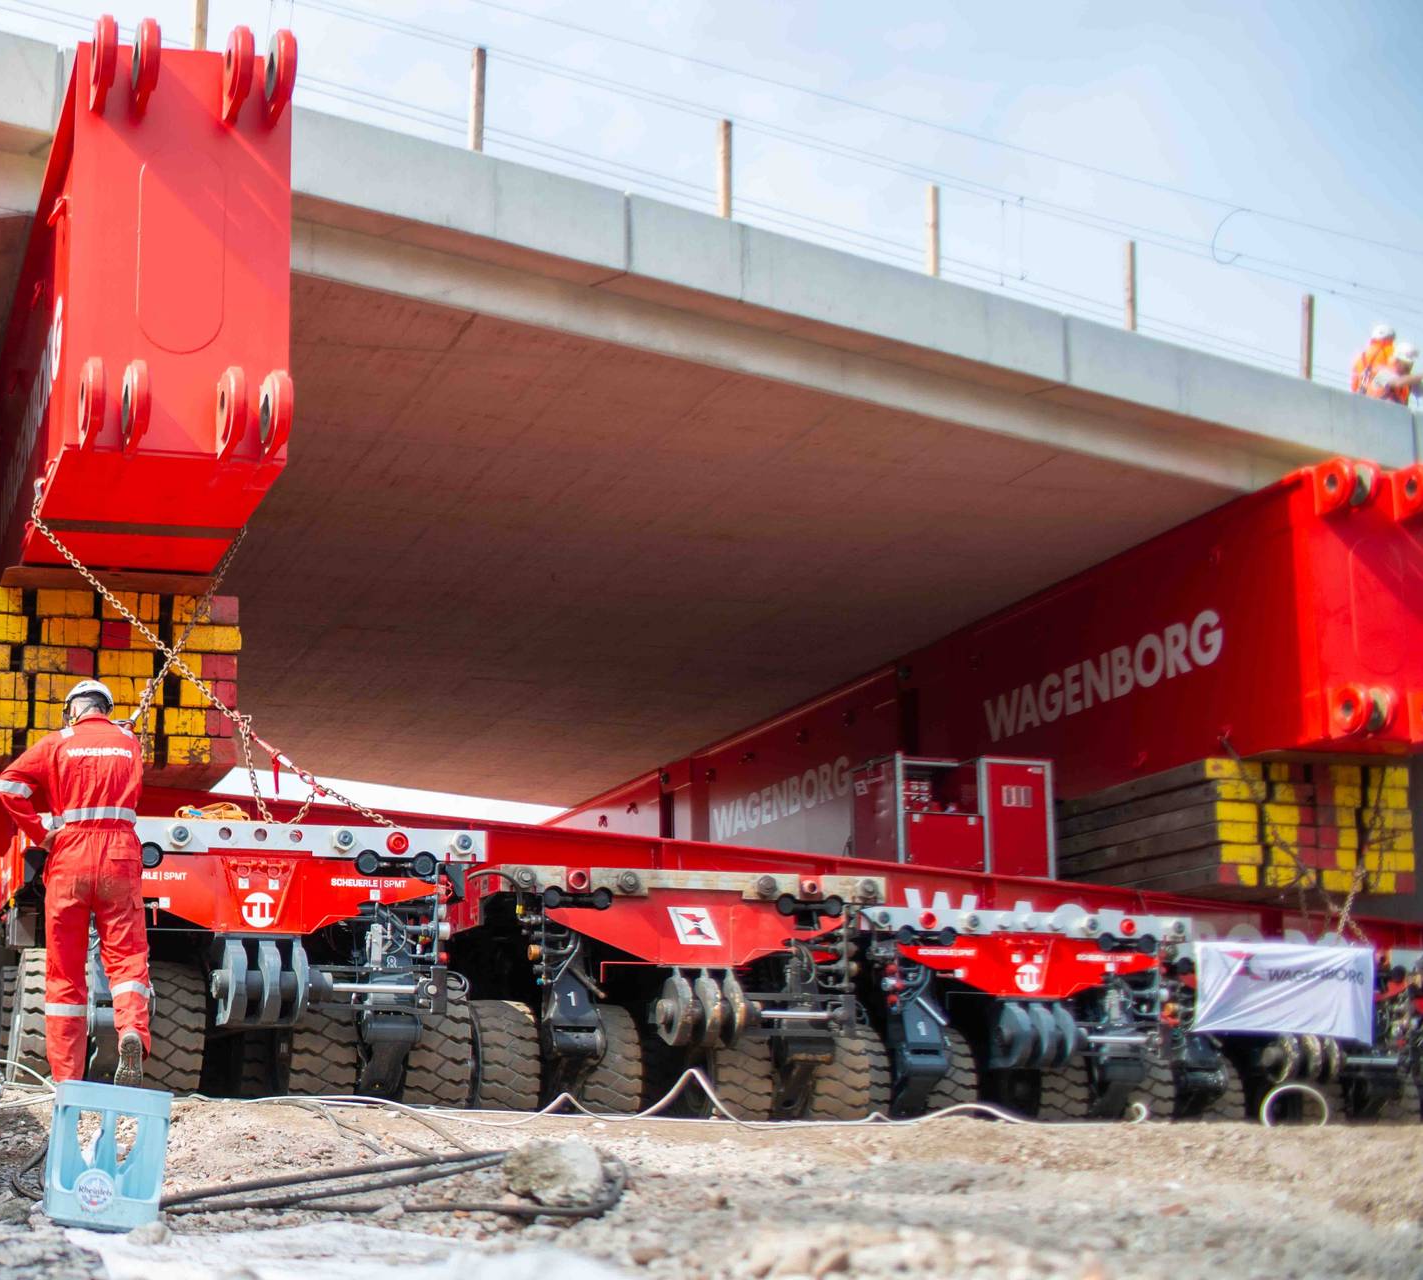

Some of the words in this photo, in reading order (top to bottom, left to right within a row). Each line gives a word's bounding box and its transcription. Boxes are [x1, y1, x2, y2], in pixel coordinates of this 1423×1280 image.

[983, 610, 1223, 742] WAGENBORG
[66, 747, 133, 760] WAGENBORG
[713, 756, 850, 841] WAGENBORG
[163, 872, 187, 880] SPMT
[330, 878, 378, 888] SCHEUERLE
[384, 880, 407, 889] SPMT
[567, 991, 576, 1007] 1
